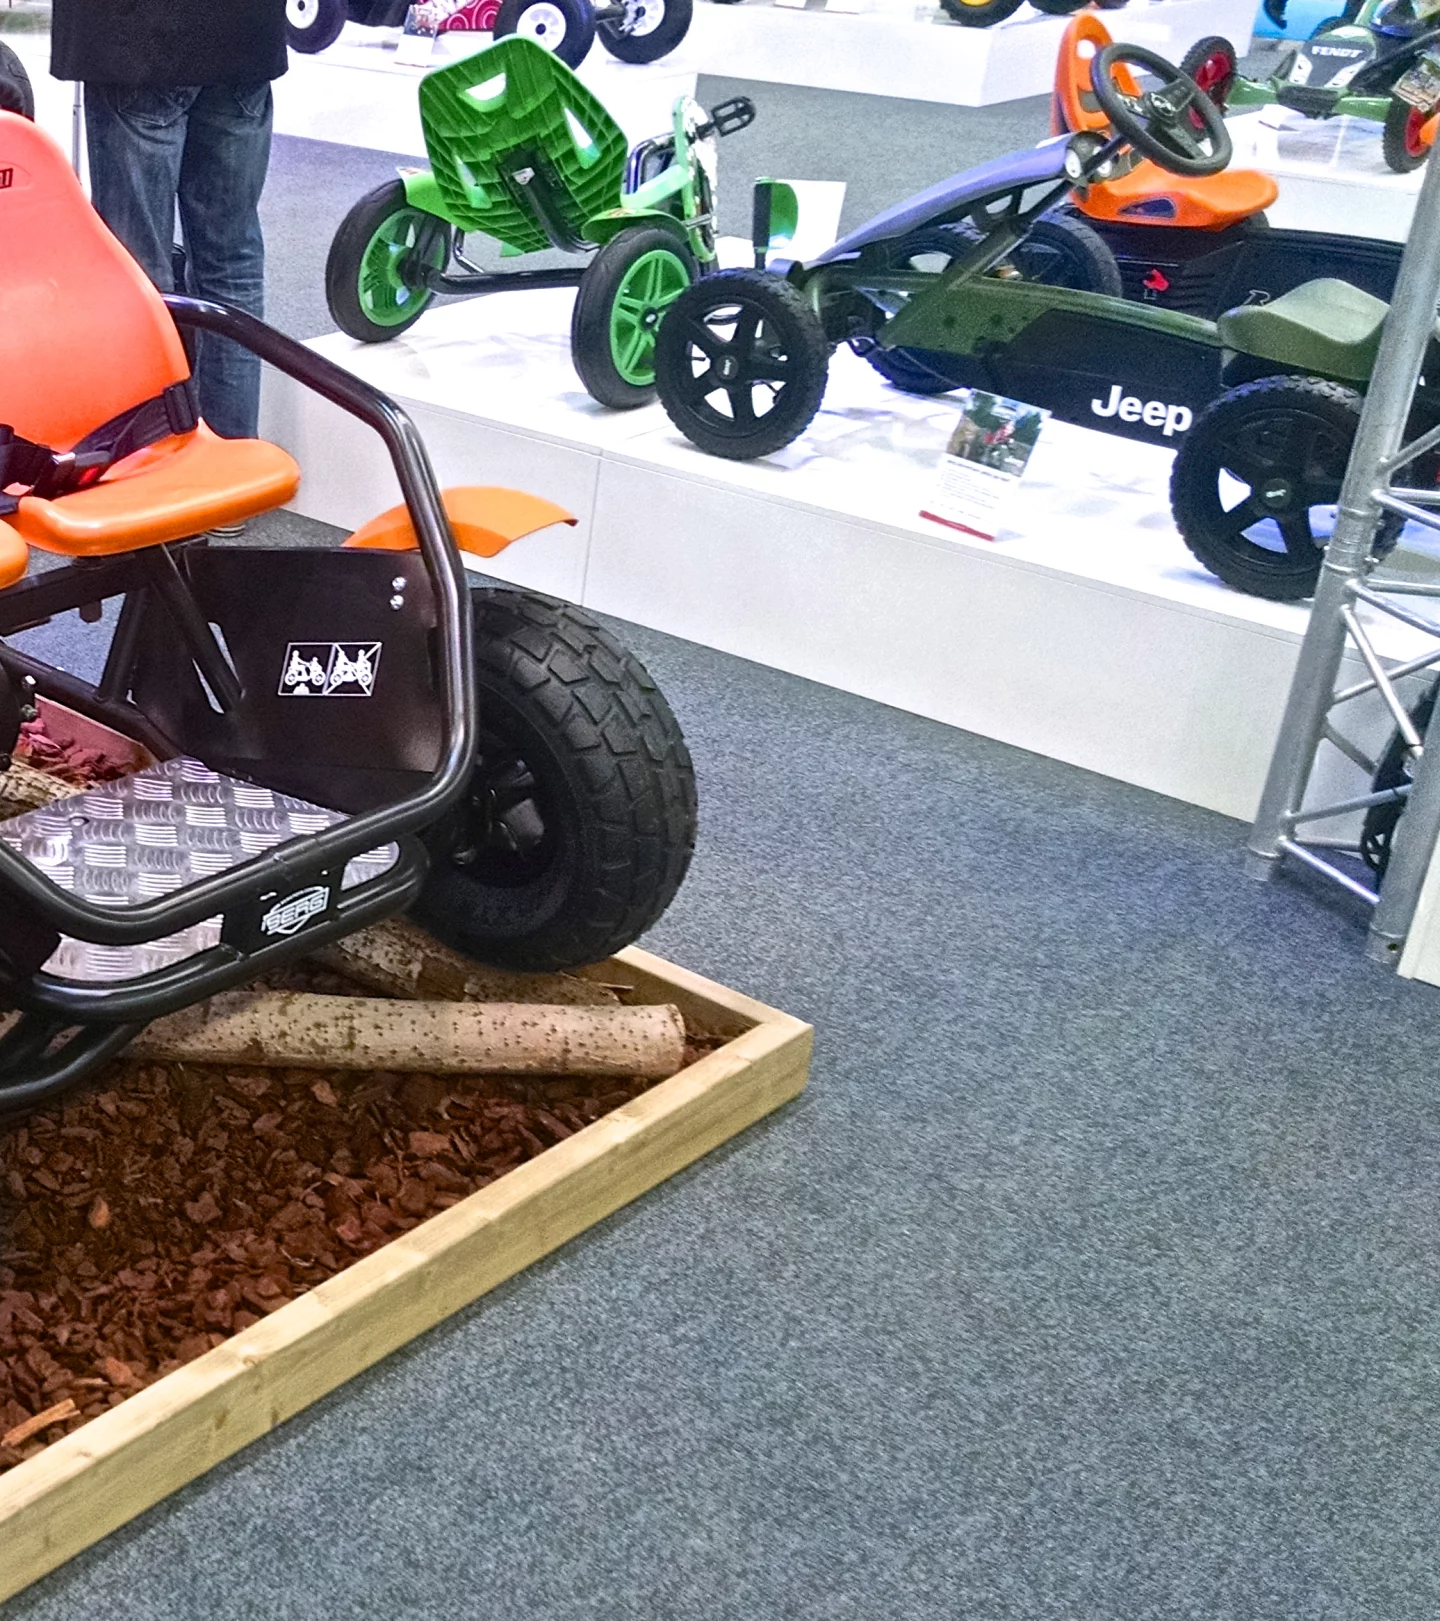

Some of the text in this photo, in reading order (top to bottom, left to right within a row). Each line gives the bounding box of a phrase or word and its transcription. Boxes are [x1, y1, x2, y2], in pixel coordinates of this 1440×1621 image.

[1311, 45, 1364, 58] FENDT
[1091, 384, 1193, 437] Jeep
[264, 895, 326, 931] BERG
